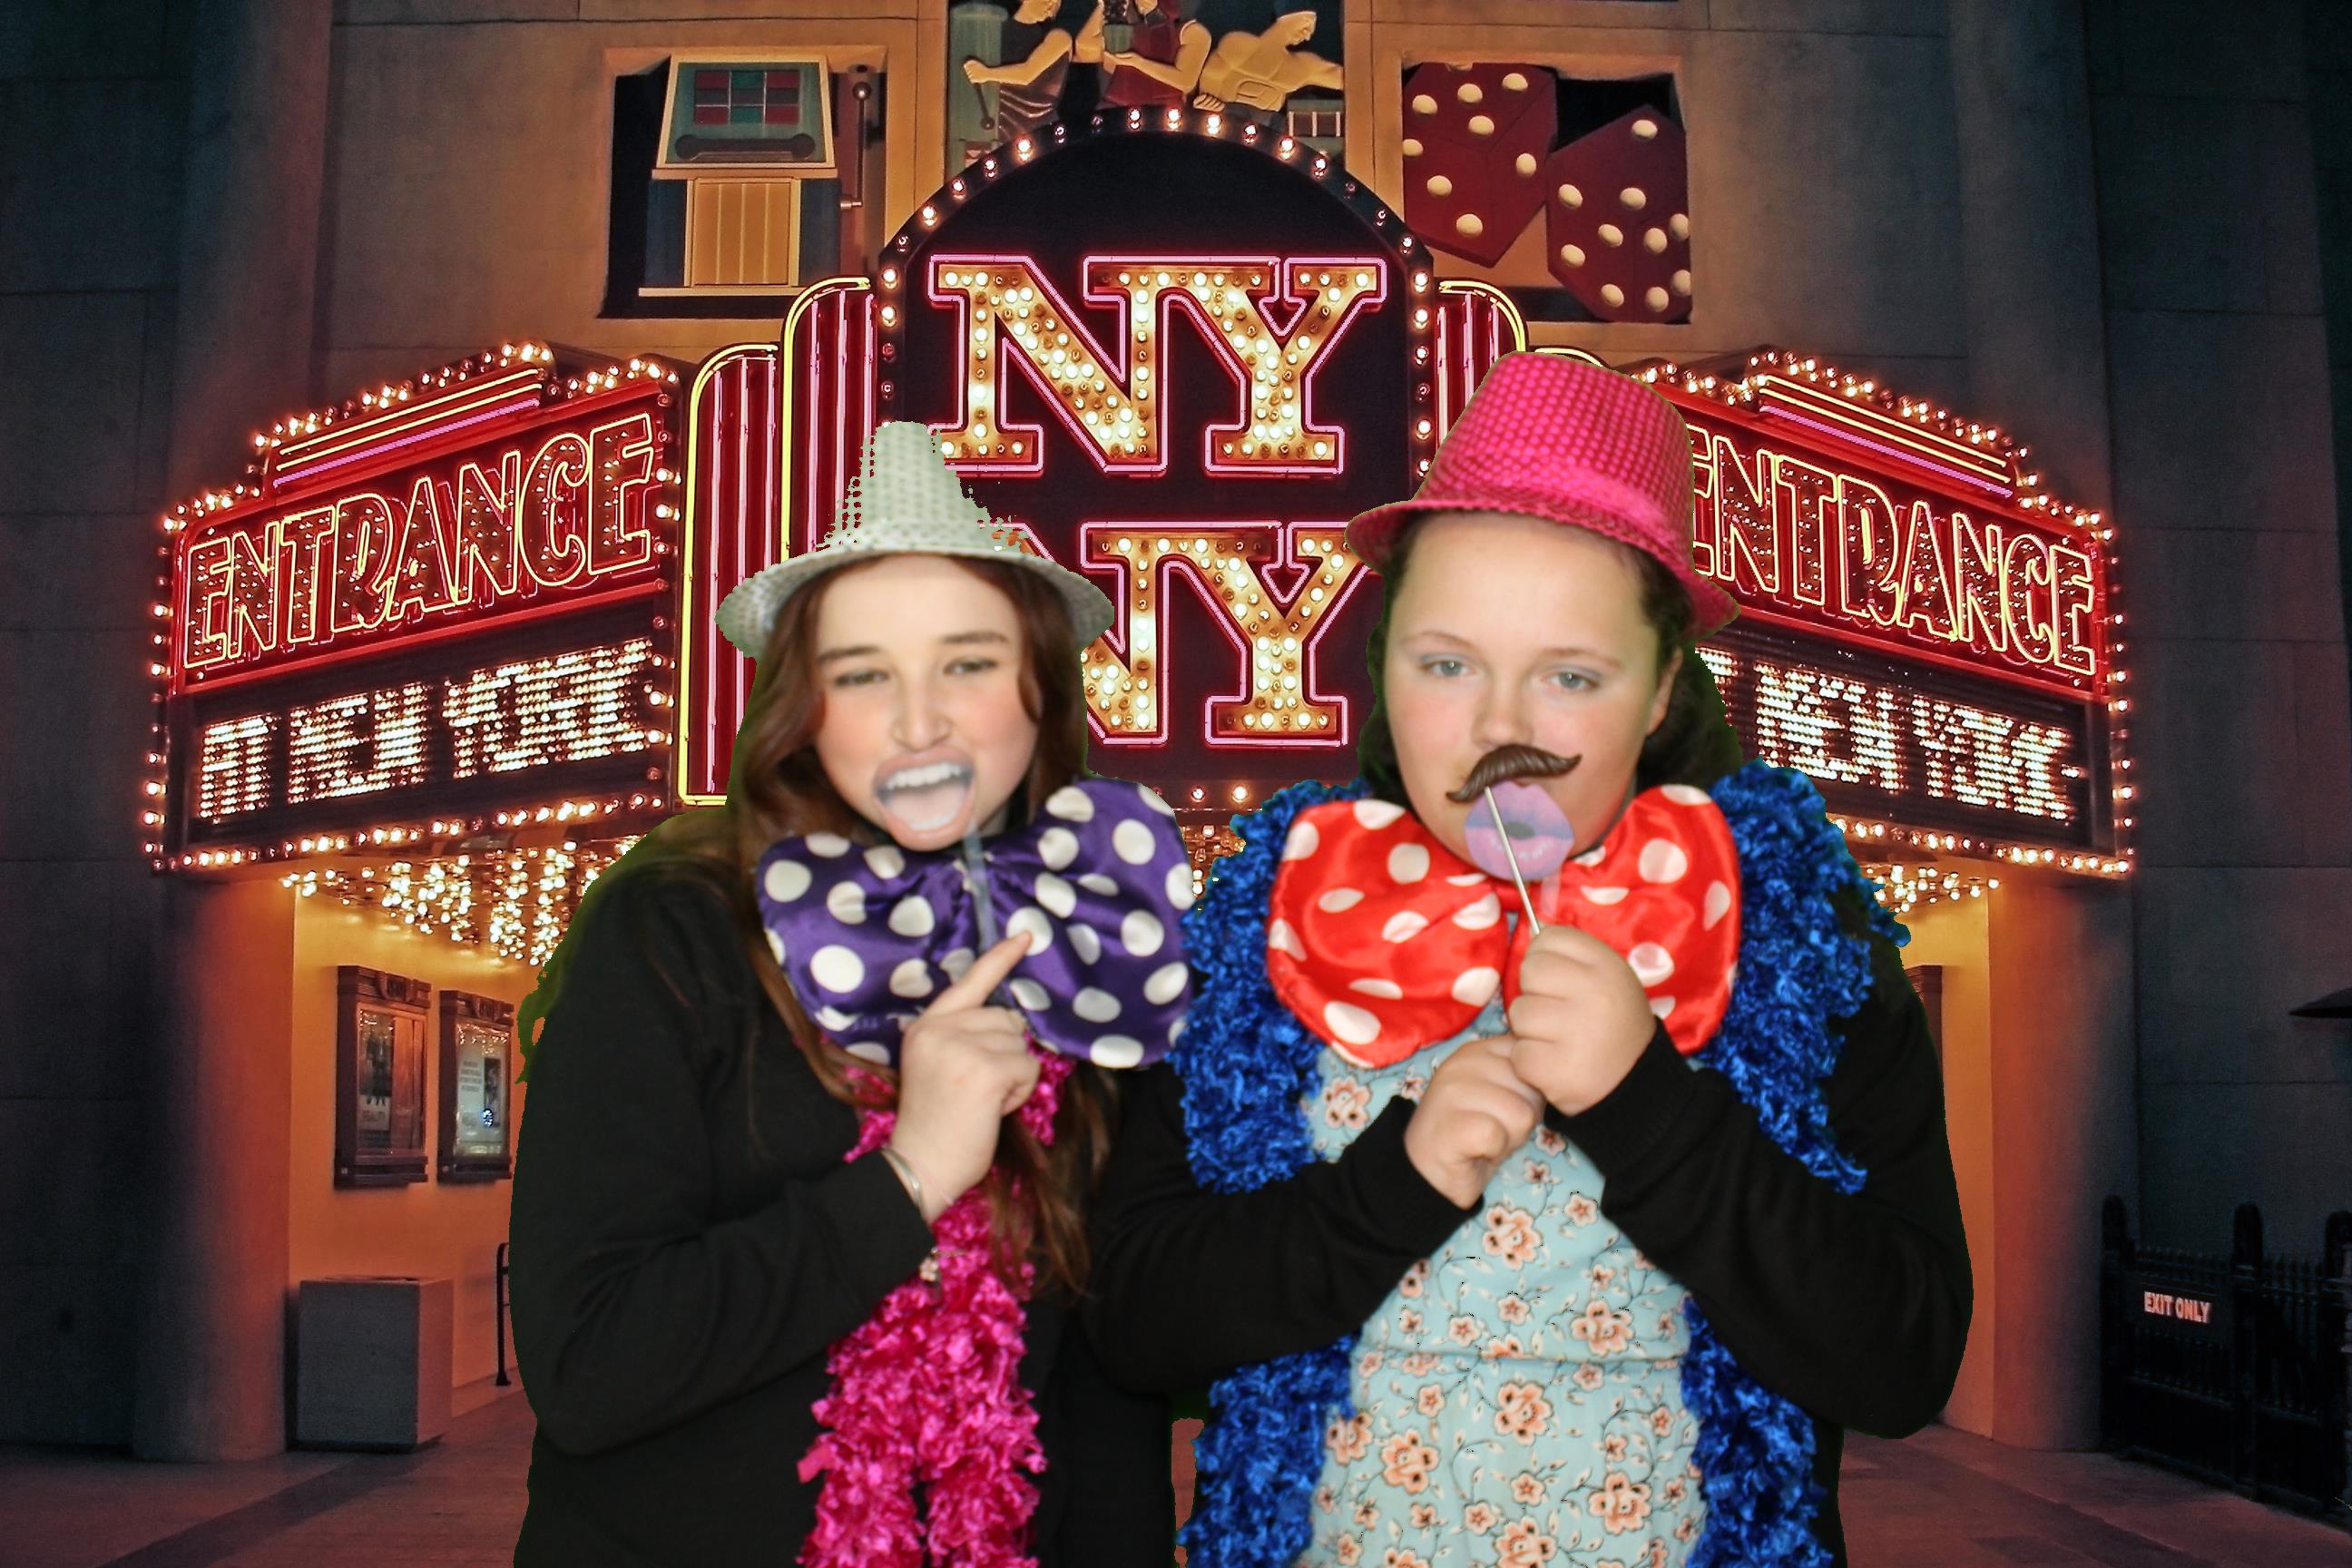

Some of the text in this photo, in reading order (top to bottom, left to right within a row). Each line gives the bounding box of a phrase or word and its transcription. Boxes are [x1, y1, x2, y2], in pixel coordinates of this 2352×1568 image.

[927, 254, 1387, 473] NY
[183, 413, 653, 669] ENTRANCE
[2144, 1291, 2211, 1323] EXIT ONLY
